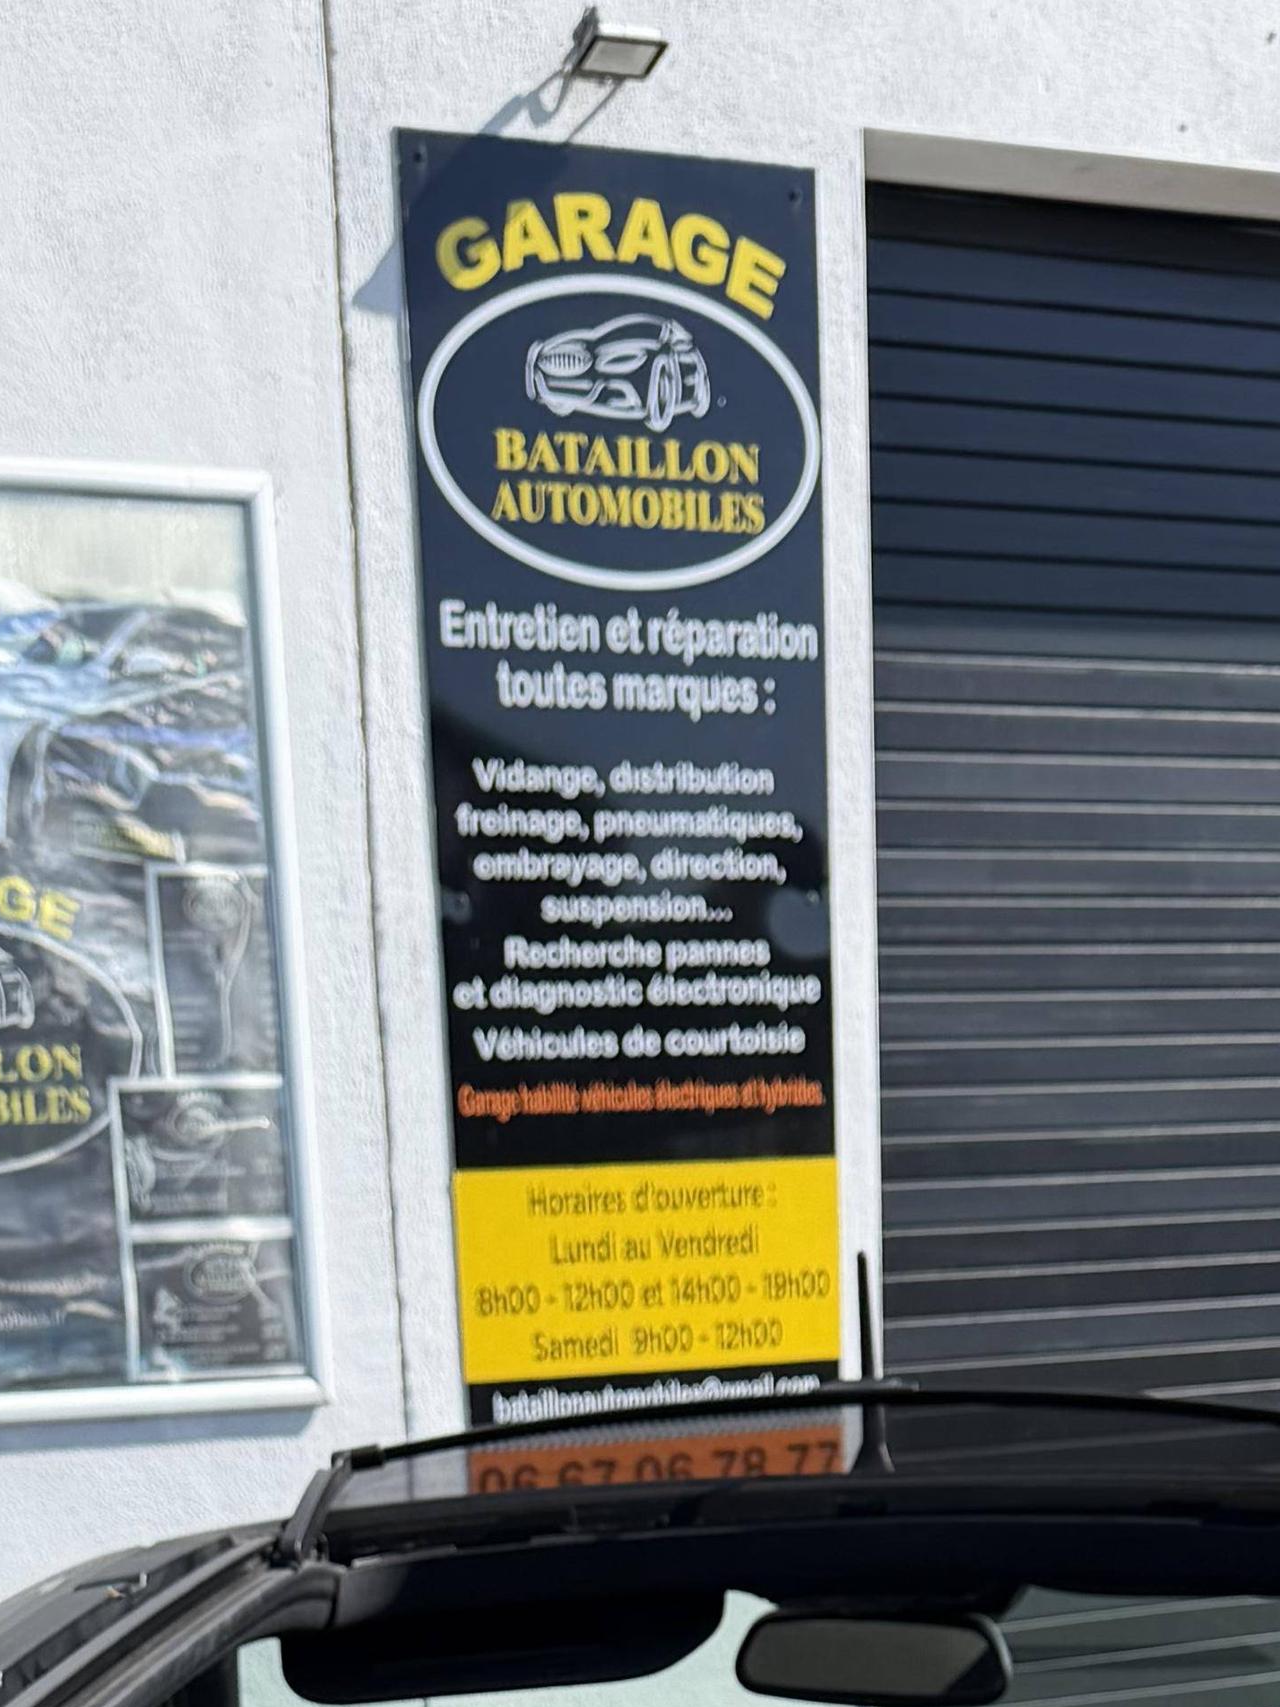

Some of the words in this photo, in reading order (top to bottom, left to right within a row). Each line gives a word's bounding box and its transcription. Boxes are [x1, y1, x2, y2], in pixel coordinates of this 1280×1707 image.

[436, 192, 786, 320] GARAGE
[494, 428, 759, 484] BATAILLON
[492, 481, 765, 535] AUTOMOBILES
[439, 598, 600, 652] Entretien
[606, 606, 643, 654] et
[647, 606, 818, 666] réparation
[496, 659, 607, 710] toutes
[471, 757, 606, 799] Vidange,
[609, 760, 775, 796] distribution
[455, 802, 589, 843] freinage,
[593, 804, 803, 844] pneumatiques,
[473, 848, 647, 887] embrayage,
[650, 848, 787, 885] direction,
[504, 934, 662, 969] Recherche
[665, 938, 771, 973] pannes
[453, 976, 488, 1010] et
[489, 973, 644, 1015] diagnostic
[647, 969, 821, 1011] électronique
[473, 1025, 619, 1061] Véhicules
[622, 1023, 661, 1058] de
[664, 1020, 806, 1058] courtoisie
[527, 1183, 626, 1217] Horaires
[549, 1235, 616, 1265] Lundi
[623, 1239, 651, 1261] au
[658, 1225, 759, 1259] Vendredi
[475, 1285, 540, 1318] 8h00
[563, 1279, 635, 1312] 12h00
[642, 1282, 665, 1308] et
[670, 1274, 742, 1309] 14h00
[532, 1329, 619, 1362] Samedi
[632, 1323, 693, 1355] 9h00
[715, 1317, 783, 1349] 12h00
[787, 1440, 839, 1474] 77
